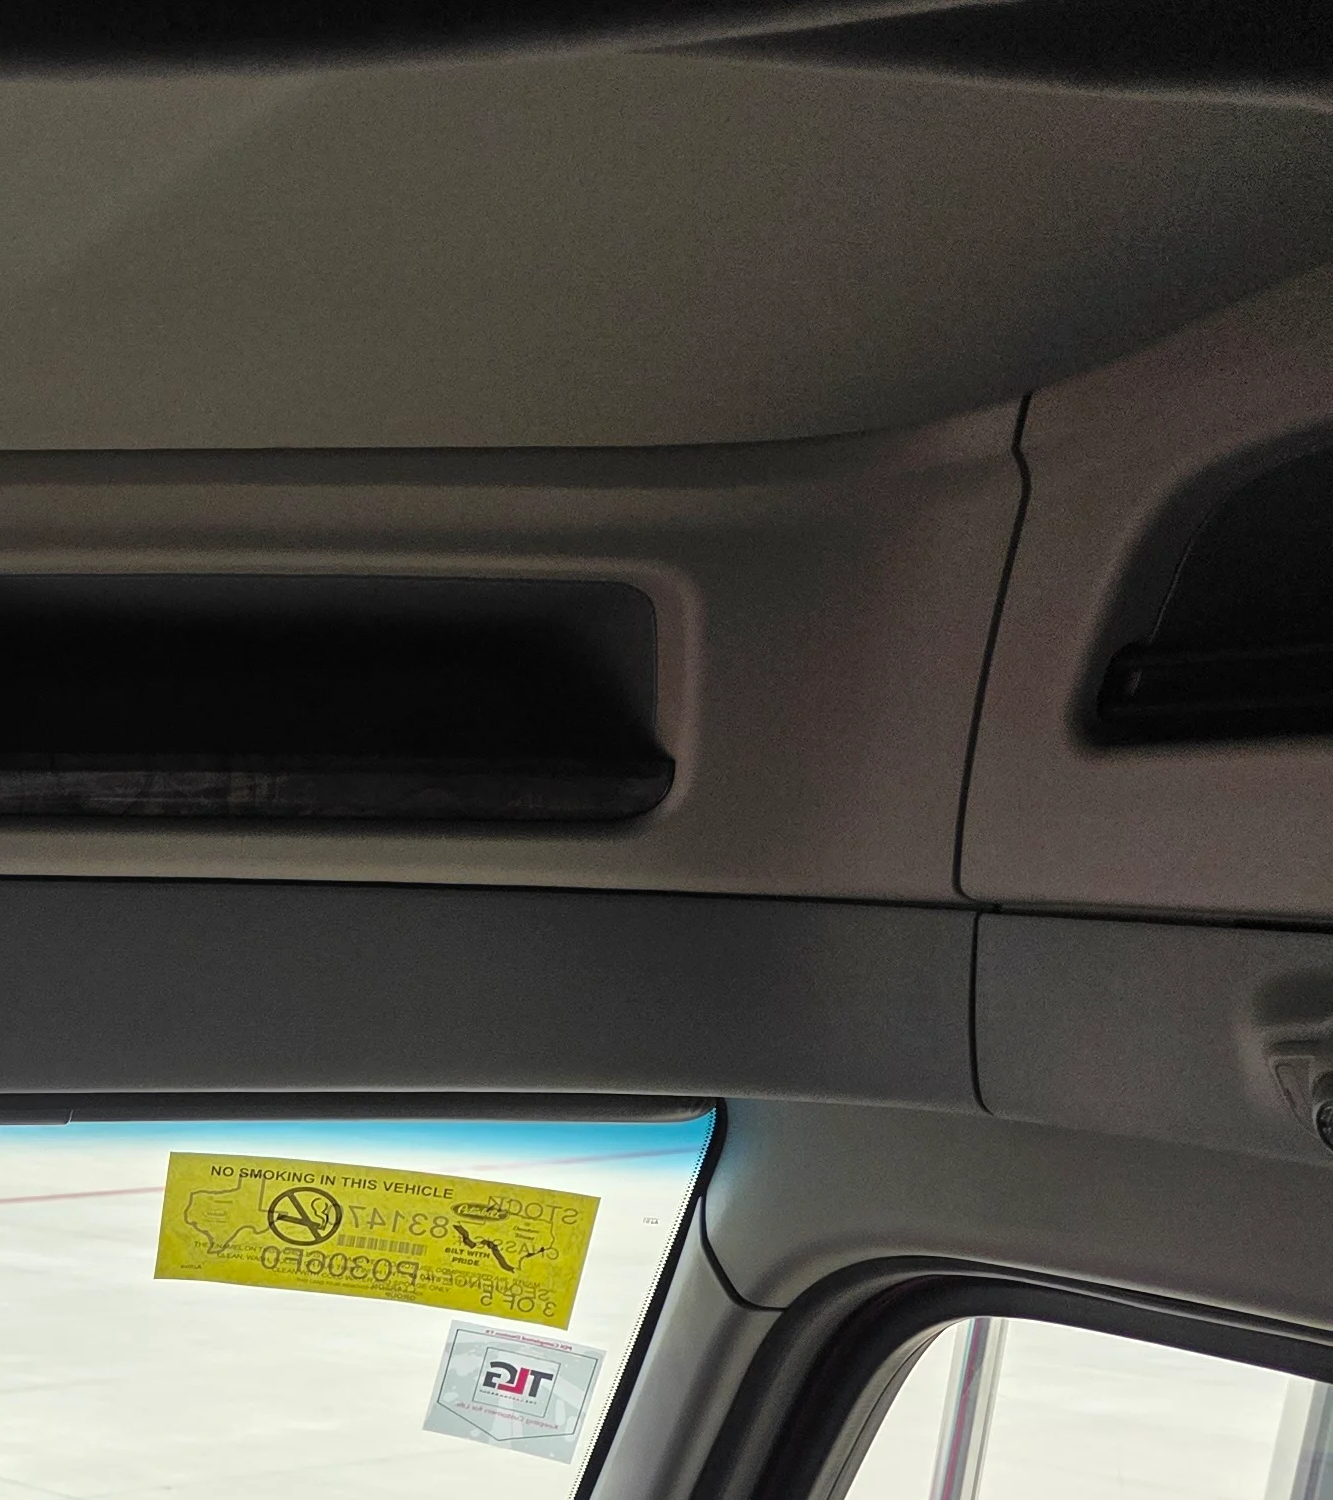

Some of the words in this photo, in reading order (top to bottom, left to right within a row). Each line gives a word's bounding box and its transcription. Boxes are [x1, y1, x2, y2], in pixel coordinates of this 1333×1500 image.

[210, 1165, 235, 1177] NO
[239, 1167, 316, 1185] SMOKING
[320, 1174, 337, 1187] IN
[341, 1176, 378, 1191] THIS
[383, 1182, 455, 1200] VEHICLE
[444, 1246, 469, 1257] BILT
[471, 1250, 492, 1260] WITH
[451, 1256, 481, 1267] PRIDE
